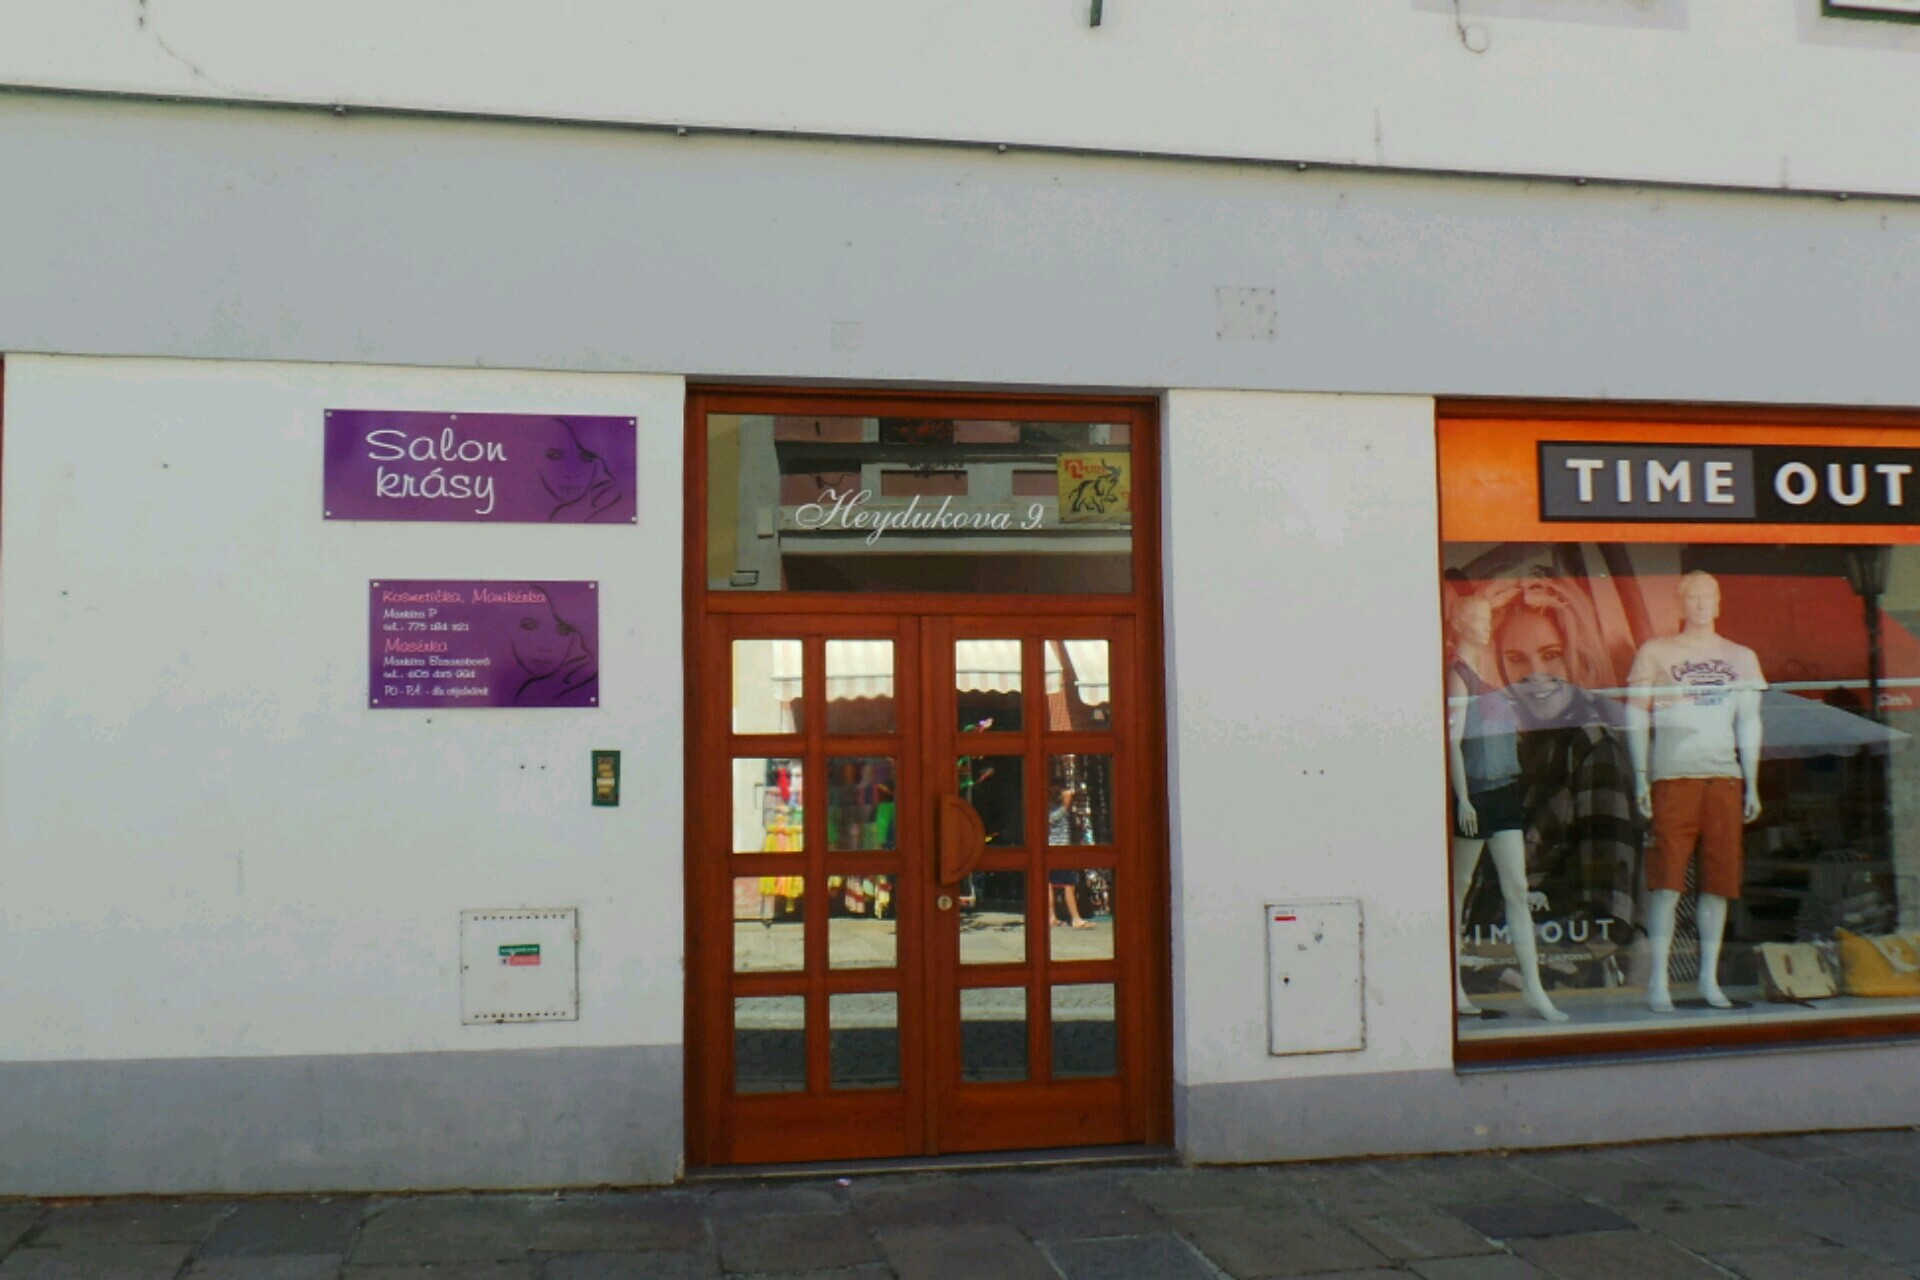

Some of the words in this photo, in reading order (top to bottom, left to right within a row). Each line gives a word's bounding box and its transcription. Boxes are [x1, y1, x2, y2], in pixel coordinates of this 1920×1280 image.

[365, 427, 507, 462] Salon
[375, 465, 495, 515] krásy
[1565, 457, 1736, 505] TIME
[1773, 461, 1913, 507] OUT
[794, 487, 1012, 546] Heydukova
[1541, 918, 1615, 944] OUT
